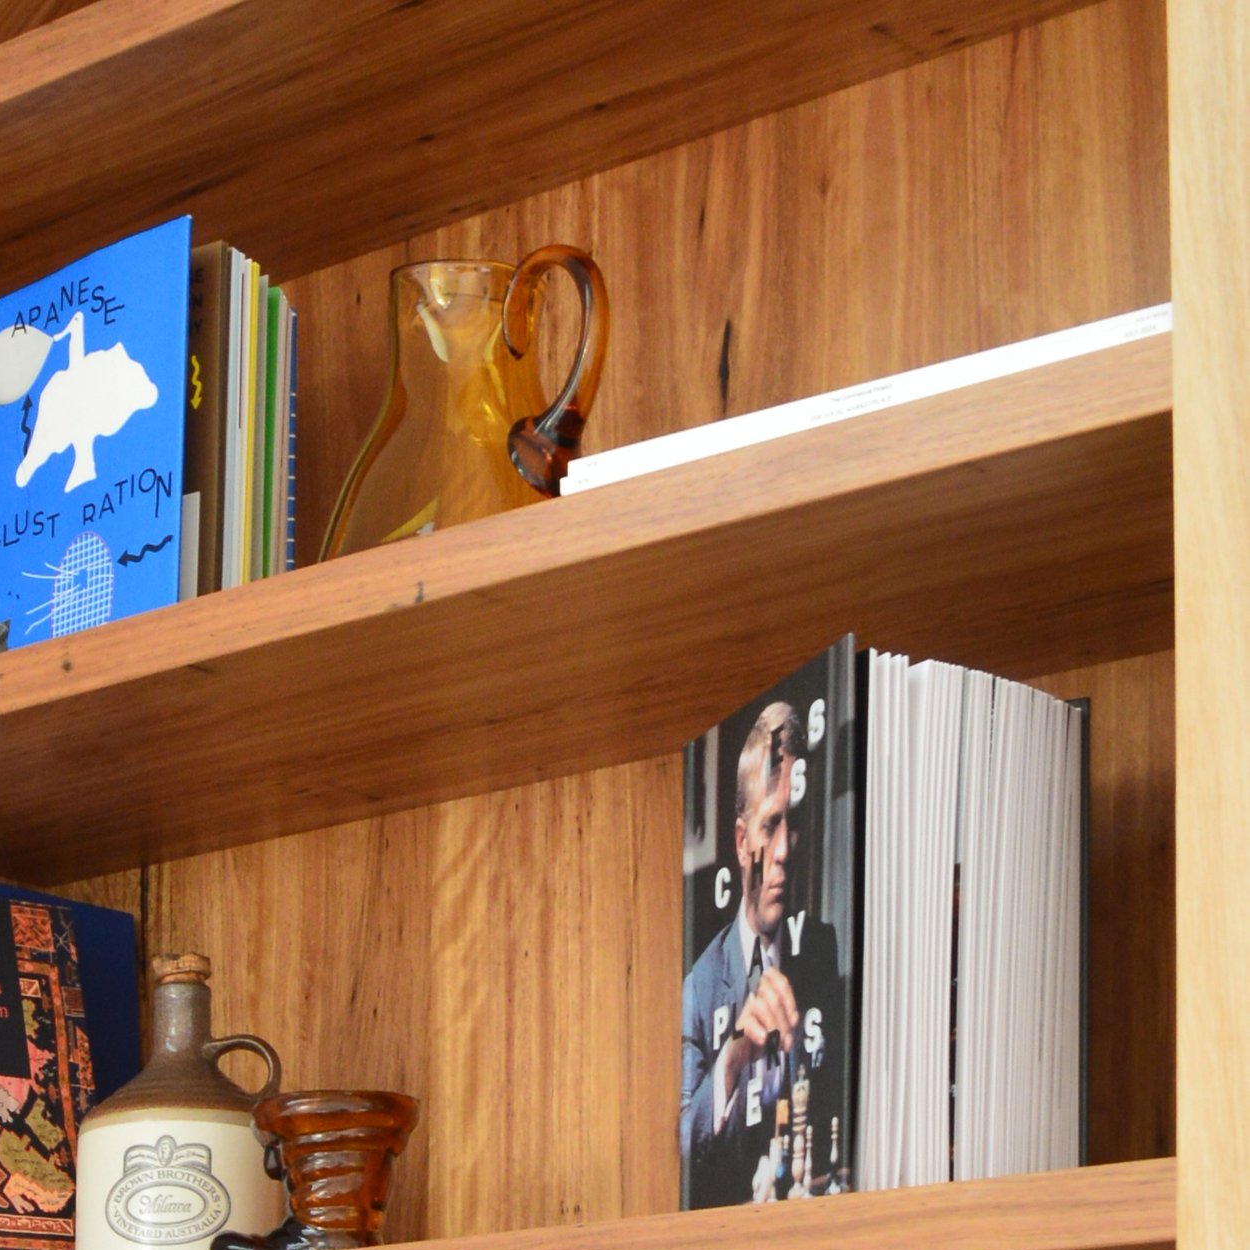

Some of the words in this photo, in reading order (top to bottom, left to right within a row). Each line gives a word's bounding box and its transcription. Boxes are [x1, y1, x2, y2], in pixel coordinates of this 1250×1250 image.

[113, 1171, 154, 1204] BROWN
[157, 1169, 221, 1203] BROTHERS
[113, 1209, 162, 1238] VINEYARD
[165, 1208, 222, 1239] AUSTRALIA
